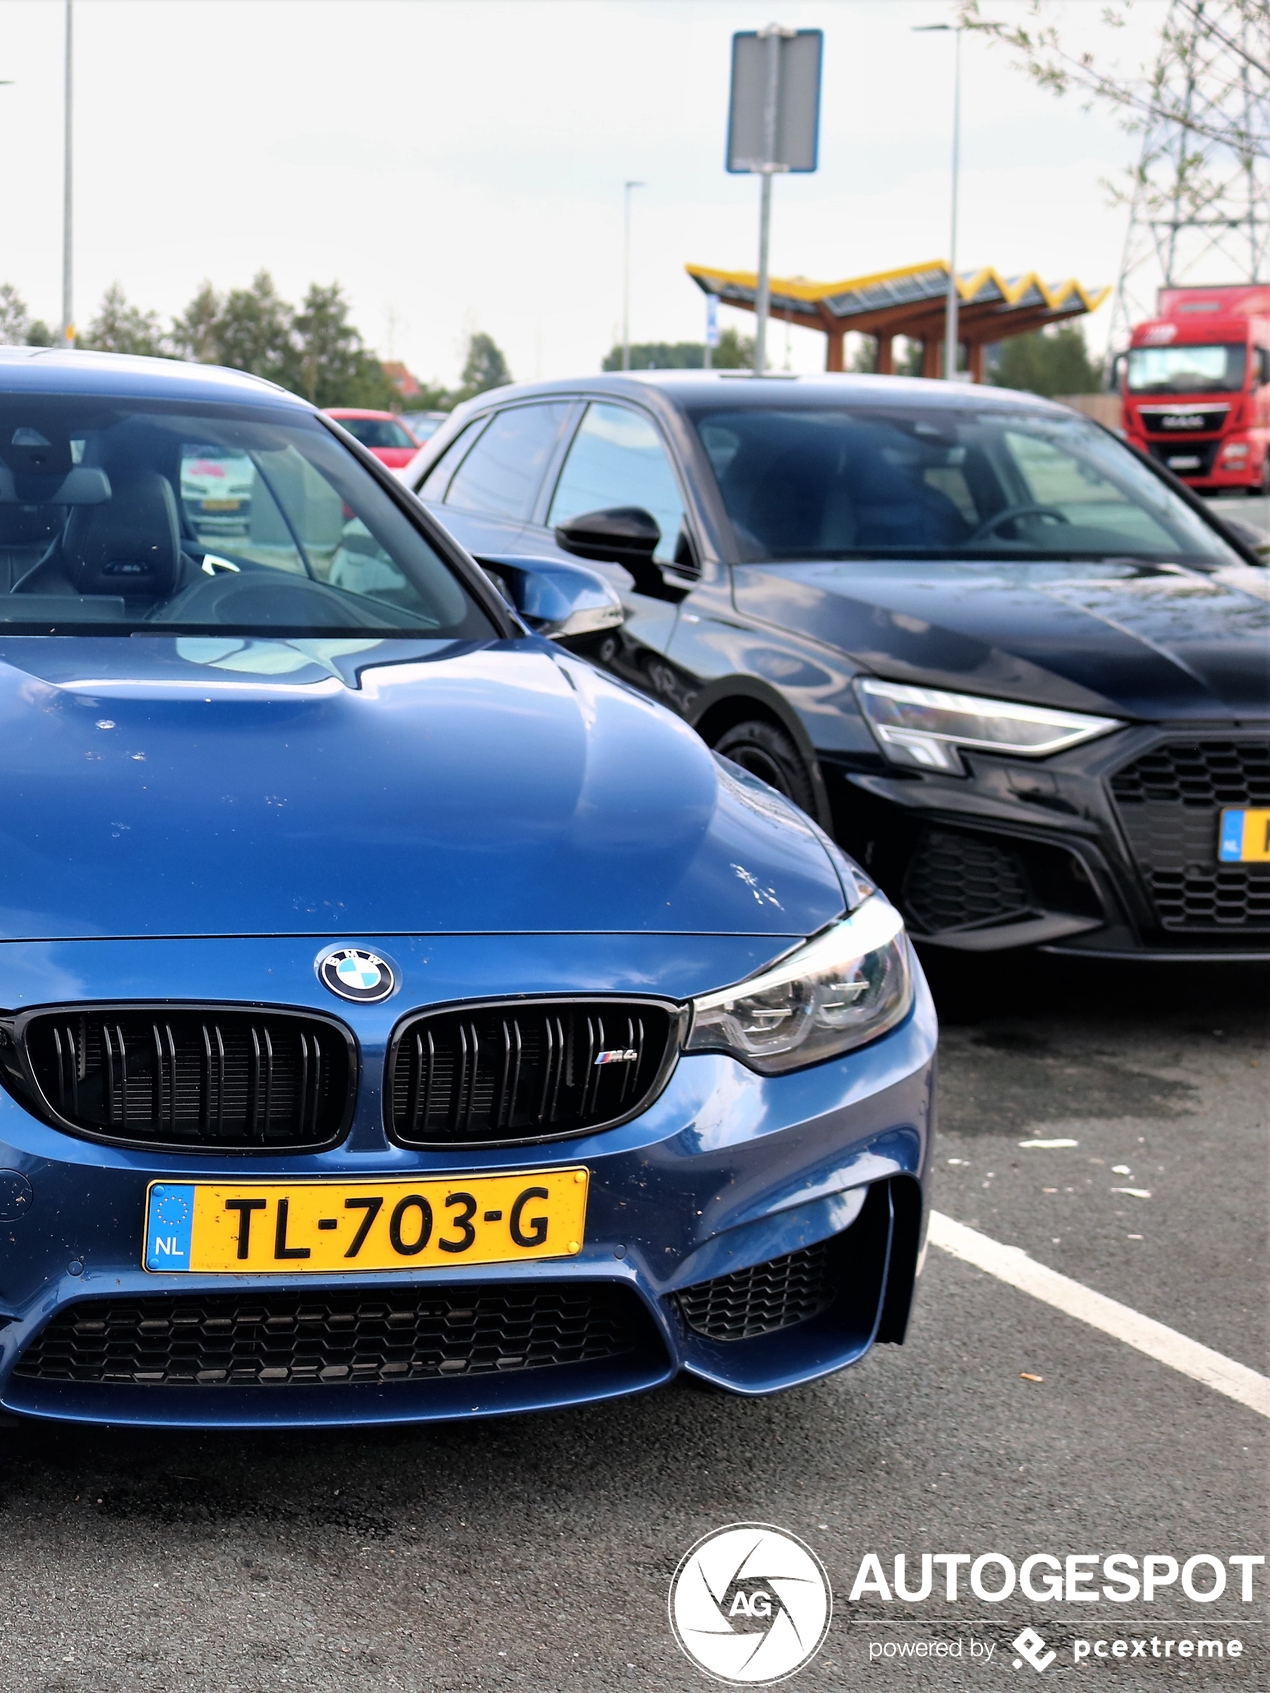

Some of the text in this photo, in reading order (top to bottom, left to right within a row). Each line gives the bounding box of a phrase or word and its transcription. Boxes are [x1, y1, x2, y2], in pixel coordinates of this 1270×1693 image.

[326, 950, 383, 967] BMW
[225, 1187, 550, 1259] TL-703-G
[155, 1236, 184, 1256] NL
